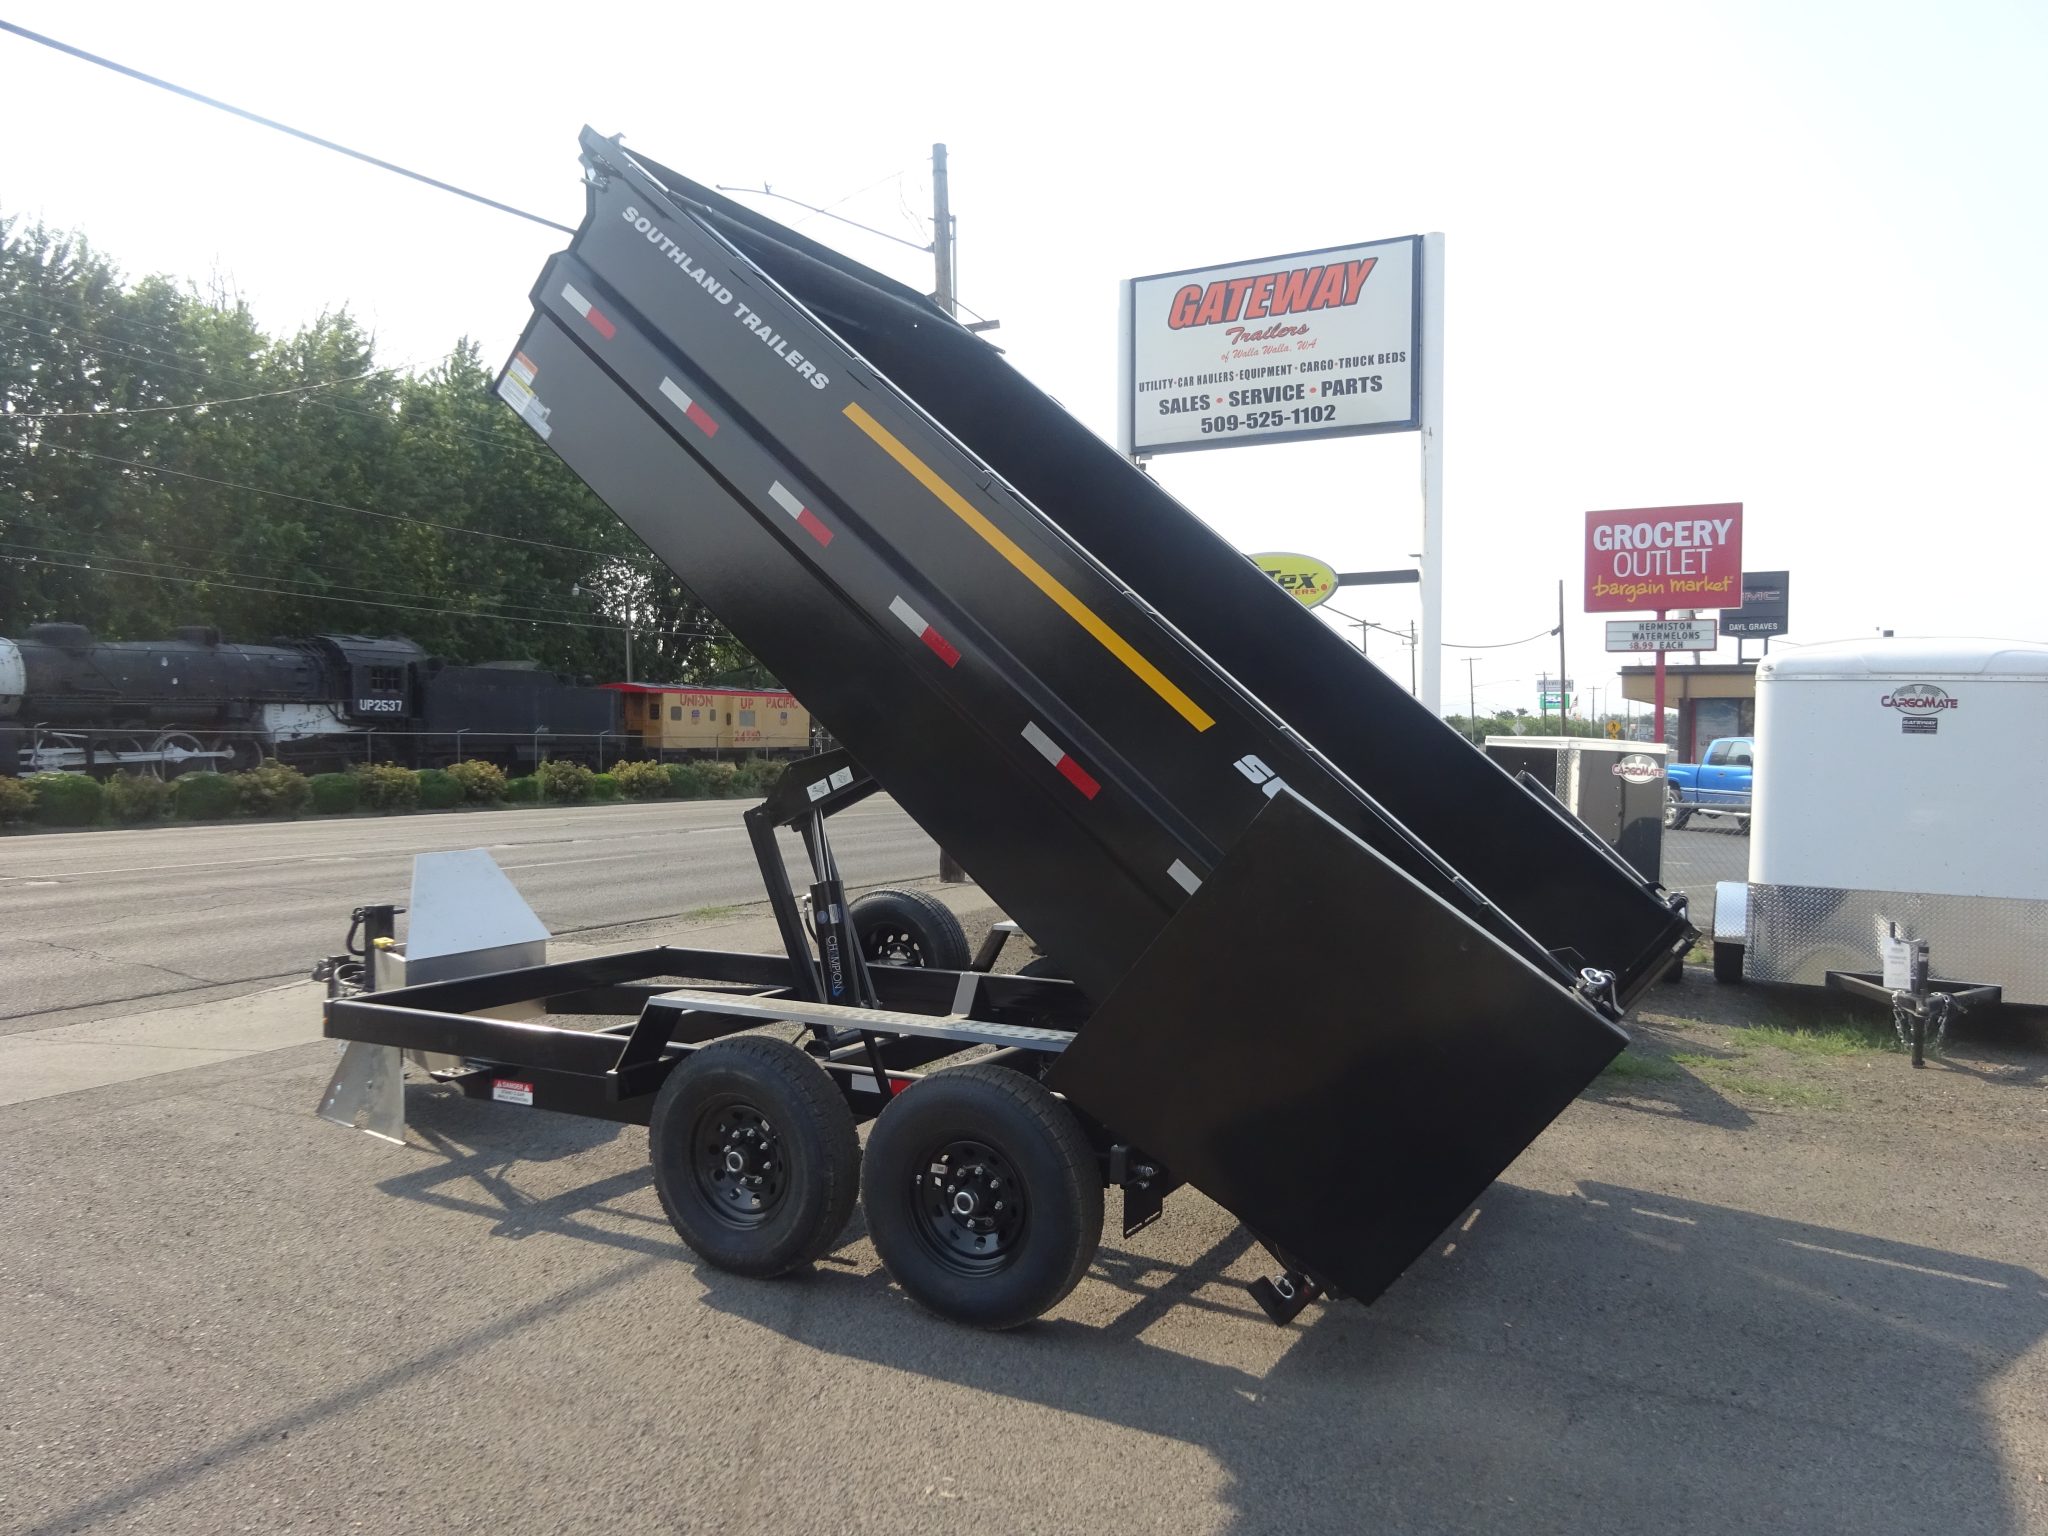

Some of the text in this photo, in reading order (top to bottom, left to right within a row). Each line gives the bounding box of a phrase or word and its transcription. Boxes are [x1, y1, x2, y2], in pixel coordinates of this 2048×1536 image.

[622, 206, 830, 391] SOUTHLAND TRAILERS
[1168, 256, 1378, 330] GATEWAY
[1225, 322, 1310, 345] Trailers
[1220, 351, 1230, 363] of
[1232, 348, 1259, 359] Walla
[1296, 338, 1318, 351] WA
[1139, 351, 1406, 393] UTILITY CAR HAULERS EQUIPMENT CARGO TRUCK BEDS
[1159, 375, 1383, 416] SALES SERVICE PARTS
[1200, 404, 1336, 434] 509-525-1102
[1593, 518, 1733, 551] GROCERY
[1613, 548, 1713, 577] OUTLET
[1592, 575, 1733, 603] bargain market
[1632, 631, 1700, 640] WATERMELONS
[1638, 622, 1693, 631] HERMISTON
[1748, 622, 1778, 631] GRAVES
[1659, 641, 1684, 649] EACH
[359, 699, 403, 712] UP2537
[680, 693, 799, 710] UNION UP PACIFIC
